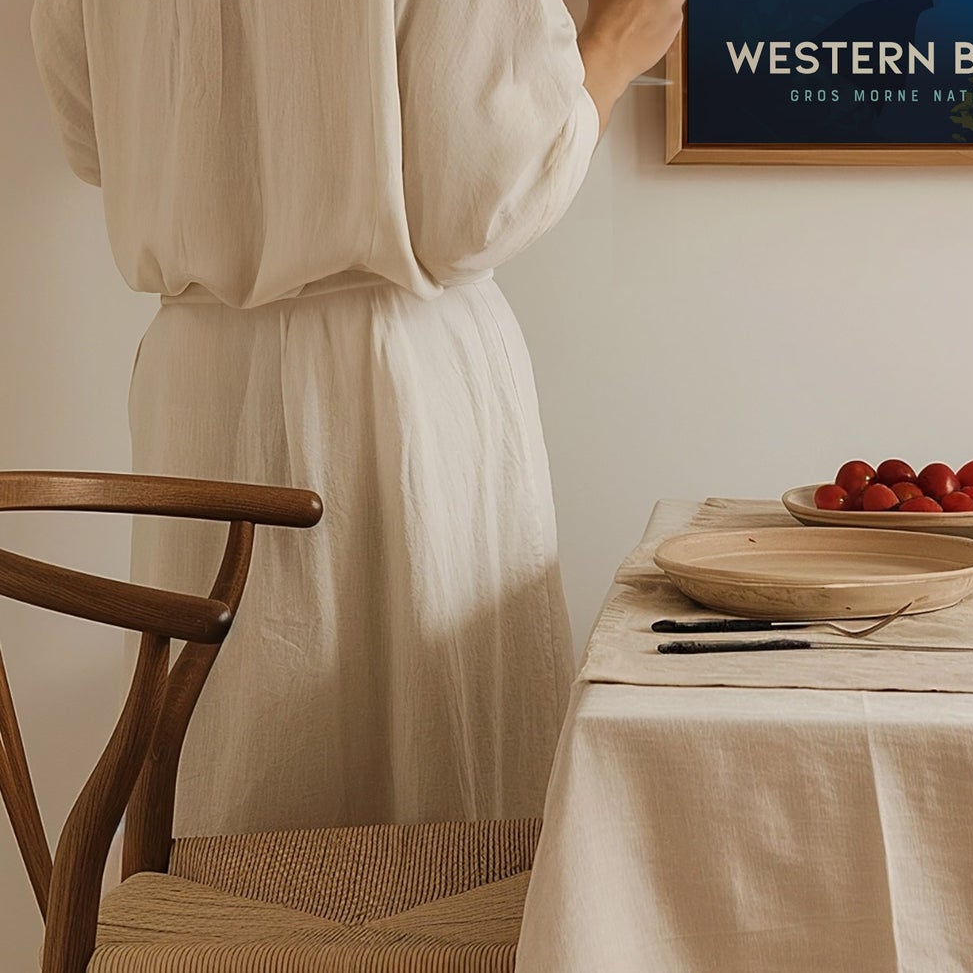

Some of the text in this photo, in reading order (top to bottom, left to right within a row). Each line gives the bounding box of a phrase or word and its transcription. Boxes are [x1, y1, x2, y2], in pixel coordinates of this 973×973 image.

[725, 41, 935, 75] WESTERN
[790, 89, 840, 102] GROS
[854, 89, 919, 102] MORNE
